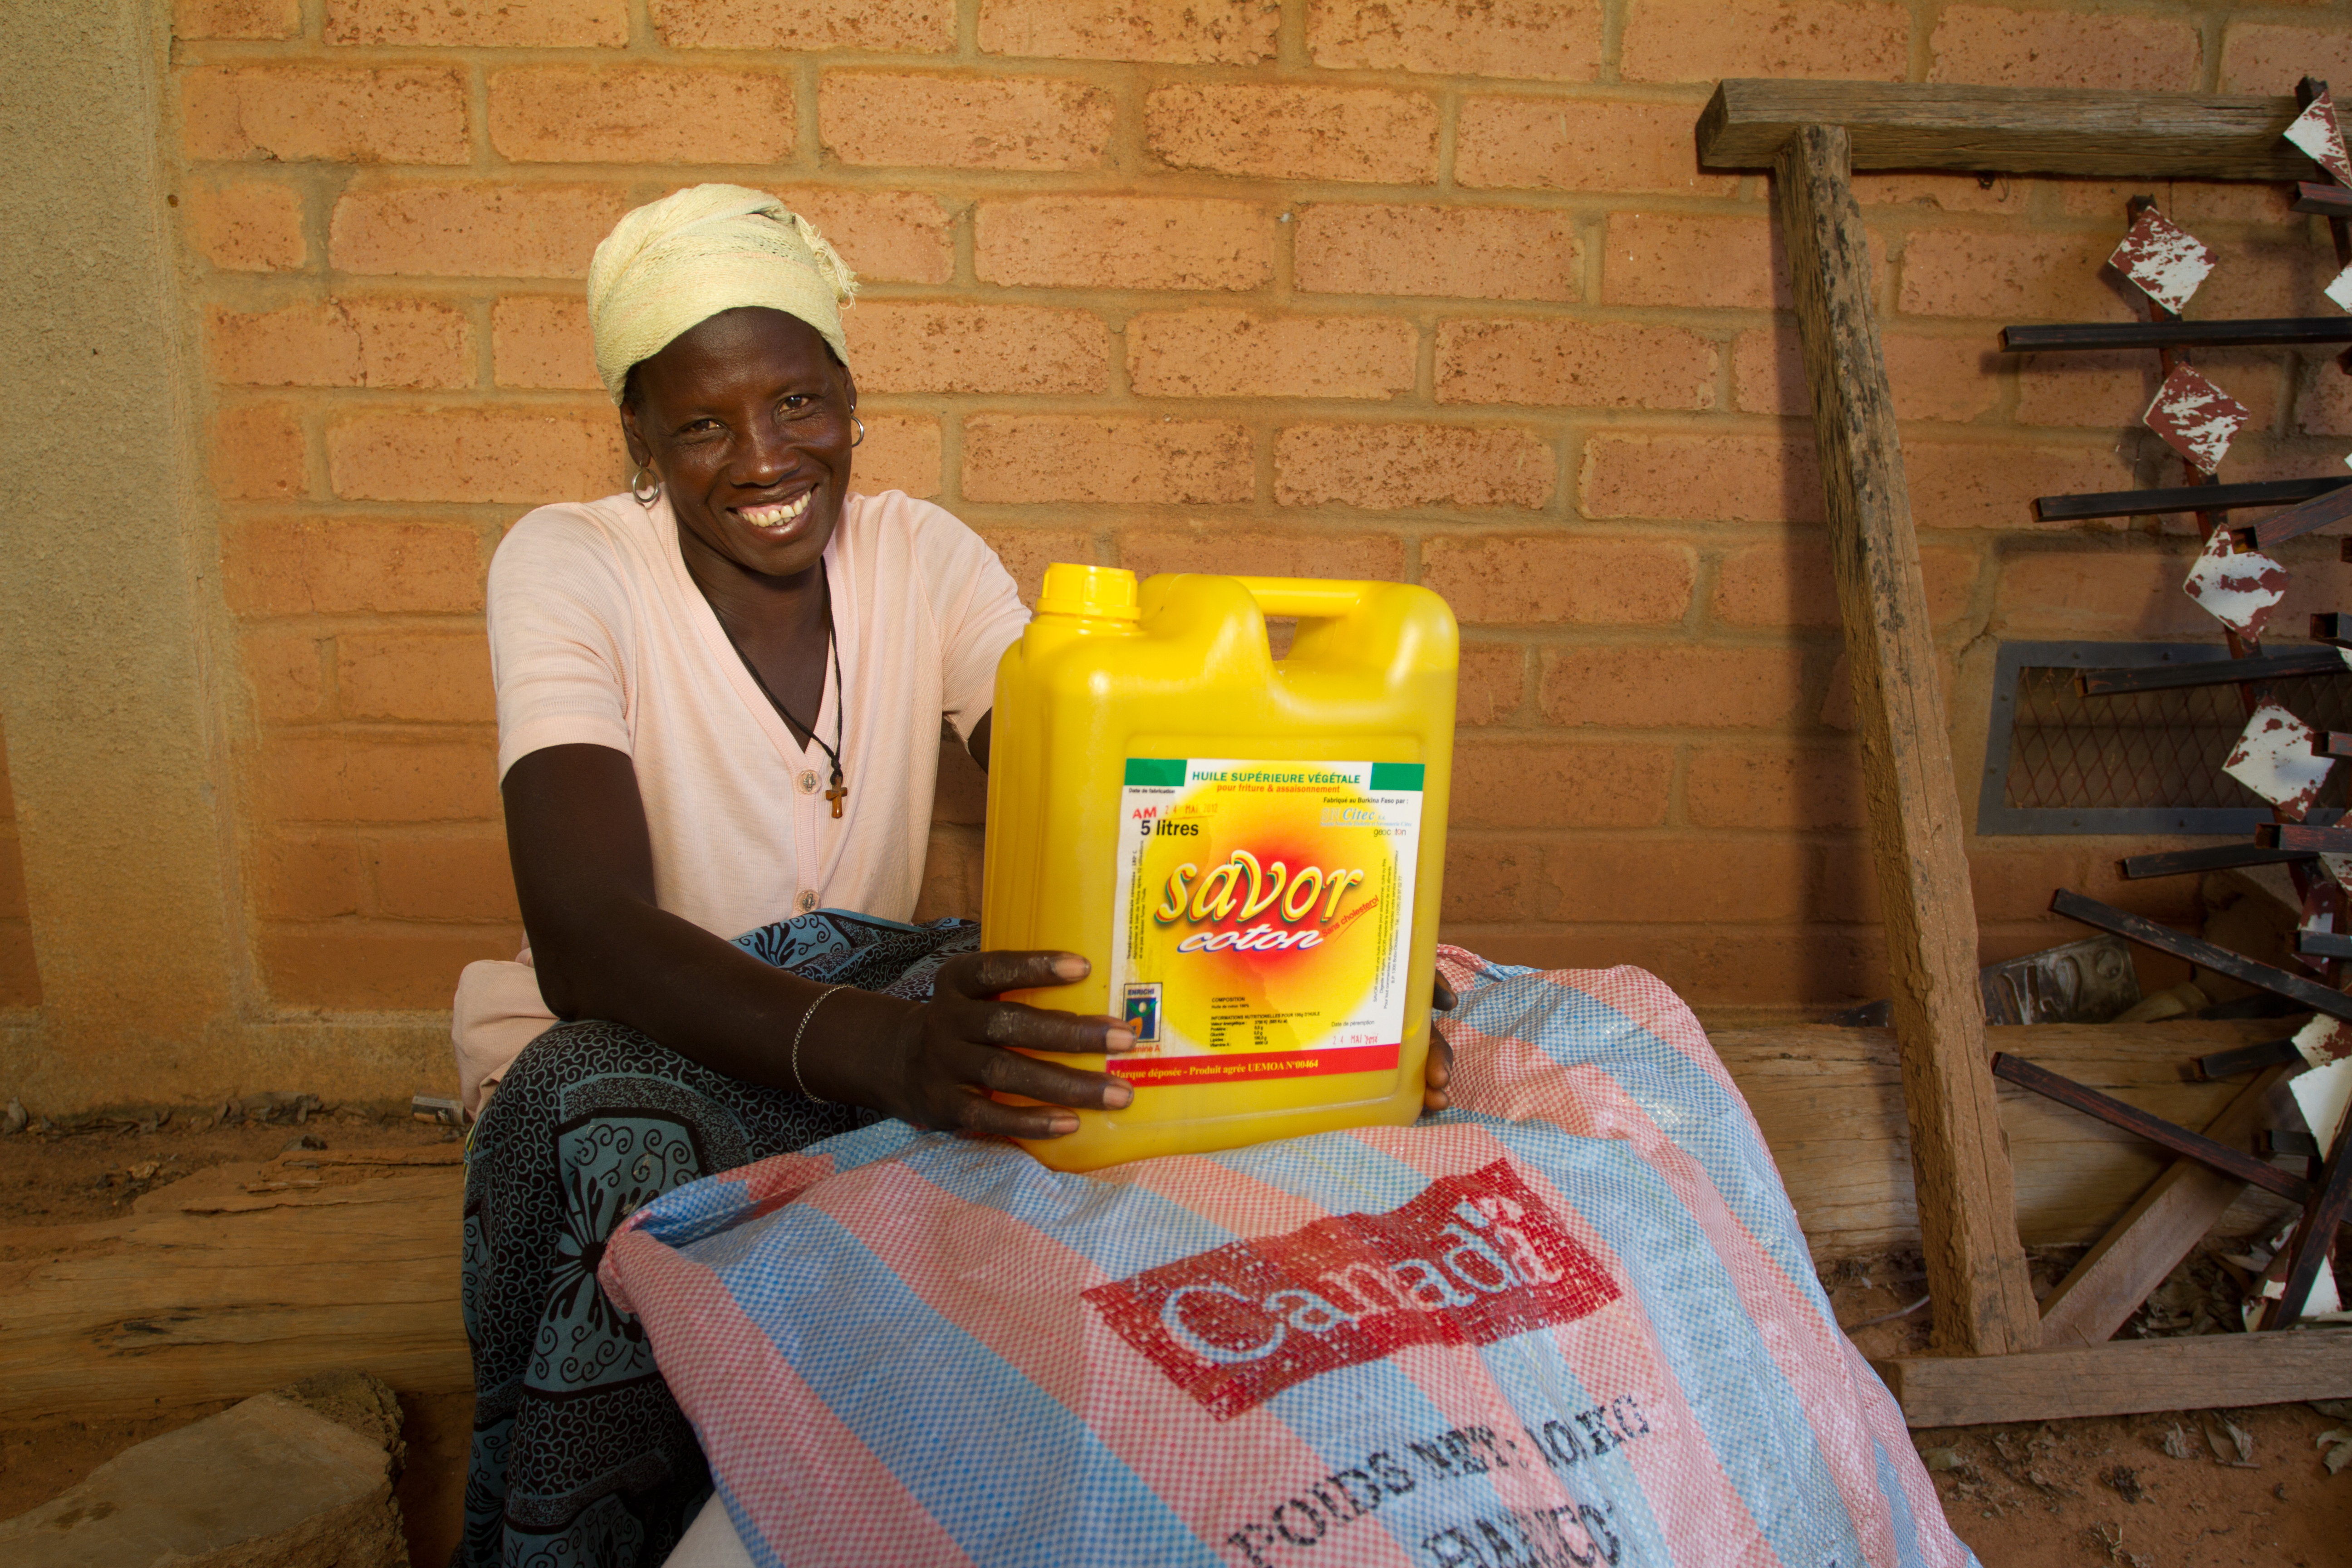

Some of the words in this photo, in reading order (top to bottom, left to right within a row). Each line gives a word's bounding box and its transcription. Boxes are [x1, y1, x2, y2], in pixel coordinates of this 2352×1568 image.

[1192, 771, 1227, 781] HUILE
[1231, 771, 1304, 783] SUPÉRIEURE
[1308, 772, 1361, 784] VÉGÉTALE
[1217, 784, 1236, 793] pour
[1239, 784, 1264, 792] friture
[1276, 785, 1340, 793] assaisonnement
[1323, 797, 1348, 805] Fabriqué
[1132, 806, 1156, 819] AM
[1321, 807, 1340, 820] SN
[1343, 807, 1375, 820] Citec
[1141, 820, 1151, 836] 5
[1156, 819, 1199, 836] litres
[1322, 922, 1341, 937] Sans
[1341, 894, 1379, 925] cholesterol
[1177, 924, 1323, 953] coton
[1351, 1034, 1362, 1044] MAI
[1147, 1067, 1182, 1079] déposée
[1190, 1065, 1221, 1075] Produit
[1223, 1064, 1246, 1075] agrée
[1248, 1062, 1284, 1072] UEMOA
[1227, 1450, 1416, 1568] POIDS
